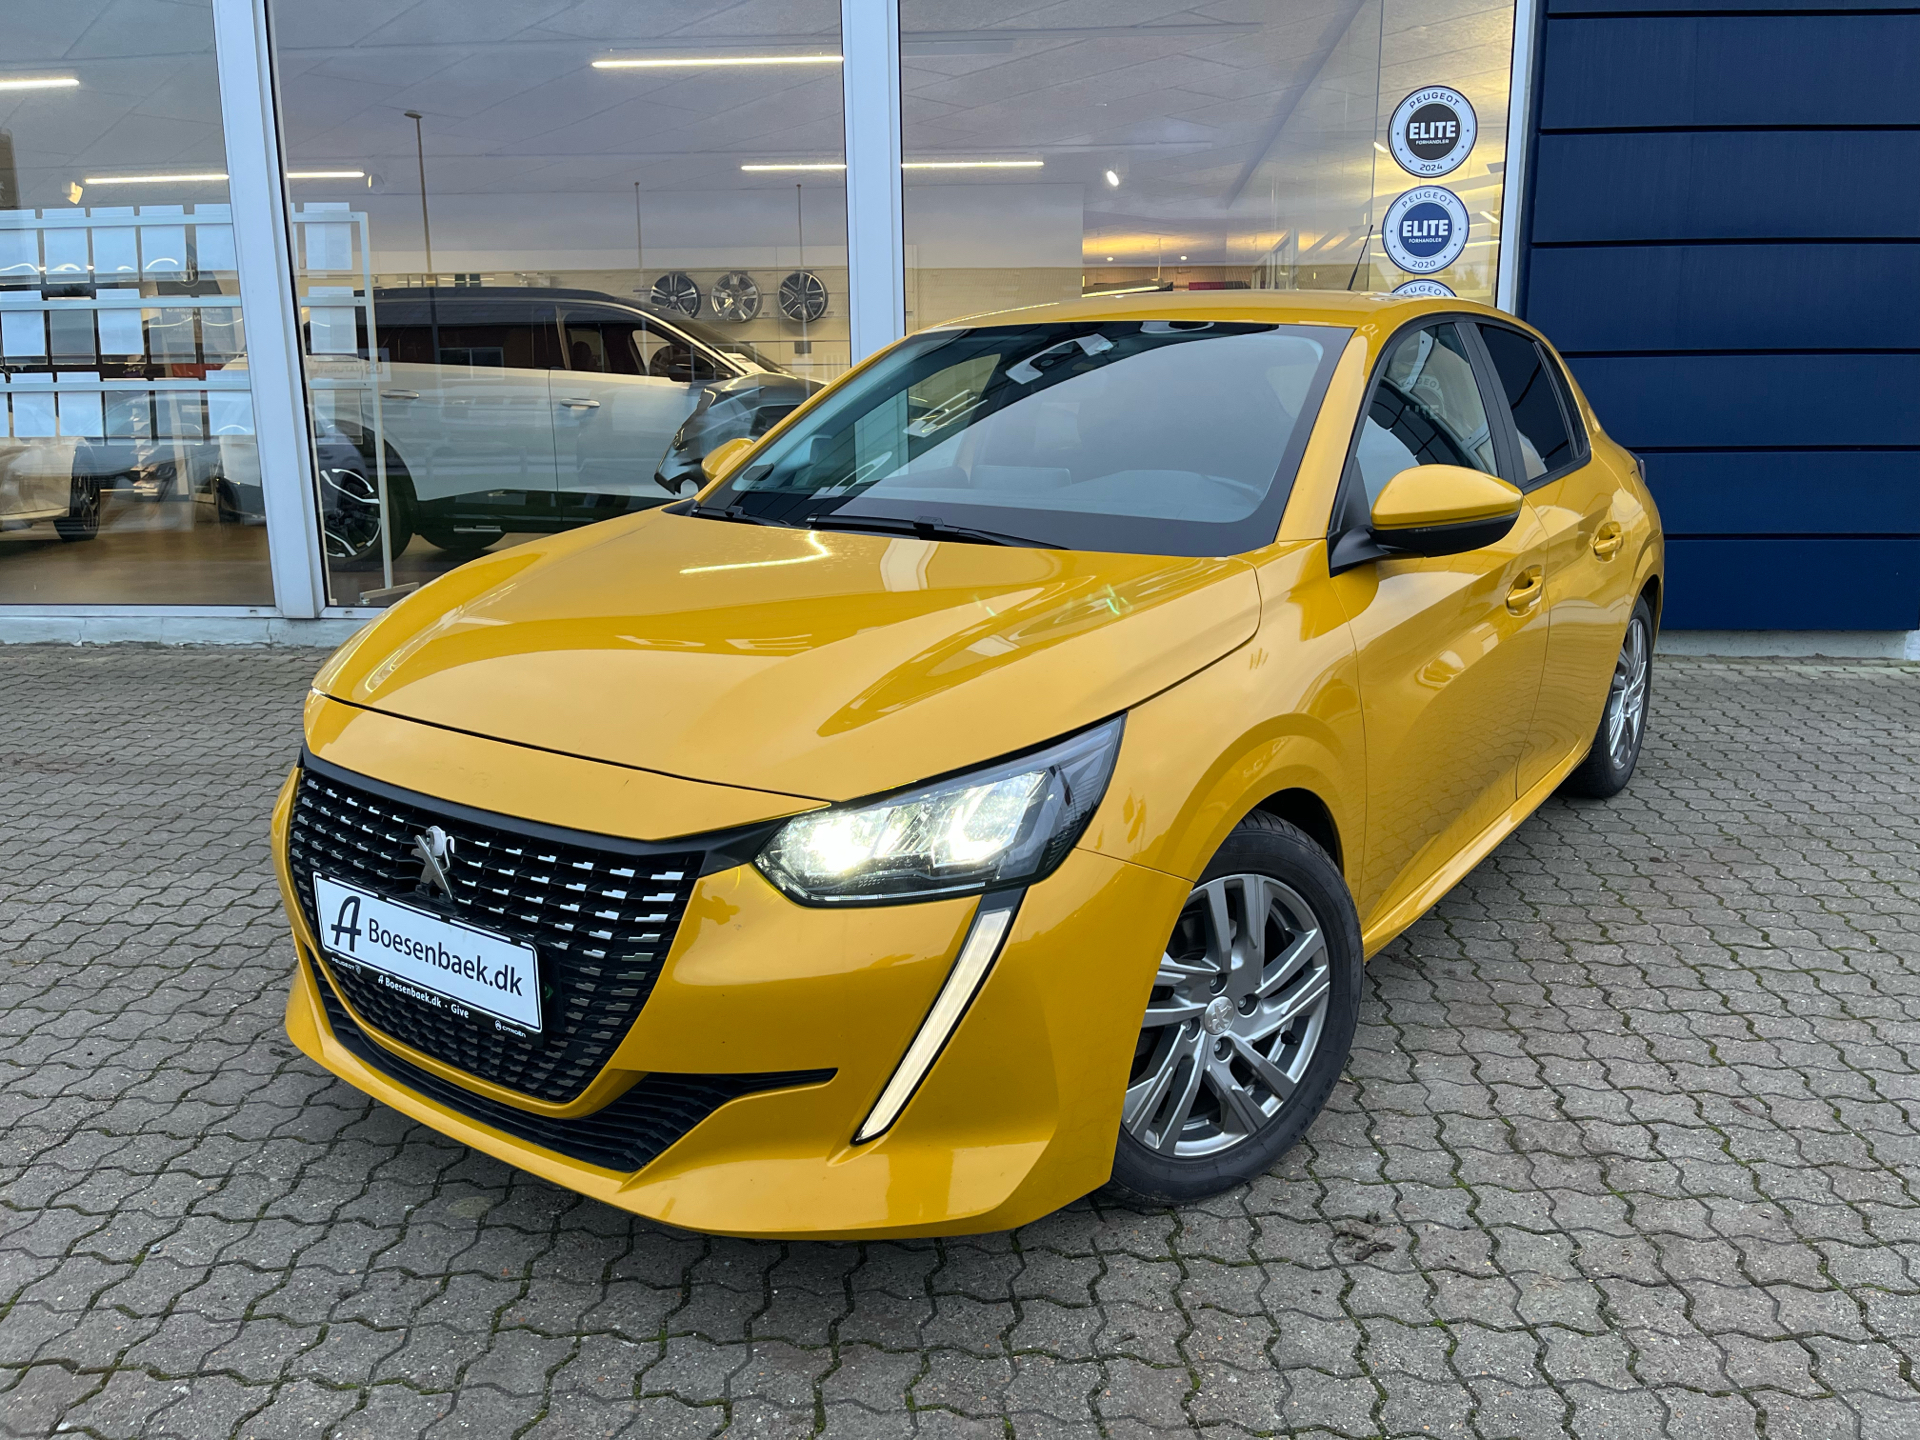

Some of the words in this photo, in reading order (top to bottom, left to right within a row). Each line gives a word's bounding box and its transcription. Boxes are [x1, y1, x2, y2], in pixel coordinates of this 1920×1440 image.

[1409, 92, 1460, 109] PEUGEOT
[1409, 121, 1456, 139] ELITE
[1401, 191, 1453, 208] PEUGEOT
[1402, 220, 1449, 237] ELITE
[1411, 260, 1436, 268] 2020
[1403, 285, 1448, 297] EUGEO
[369, 918, 523, 996] Boesenbaek.dk
[385, 977, 441, 1008] Boesenbaek.dk
[450, 1003, 469, 1018] Give
